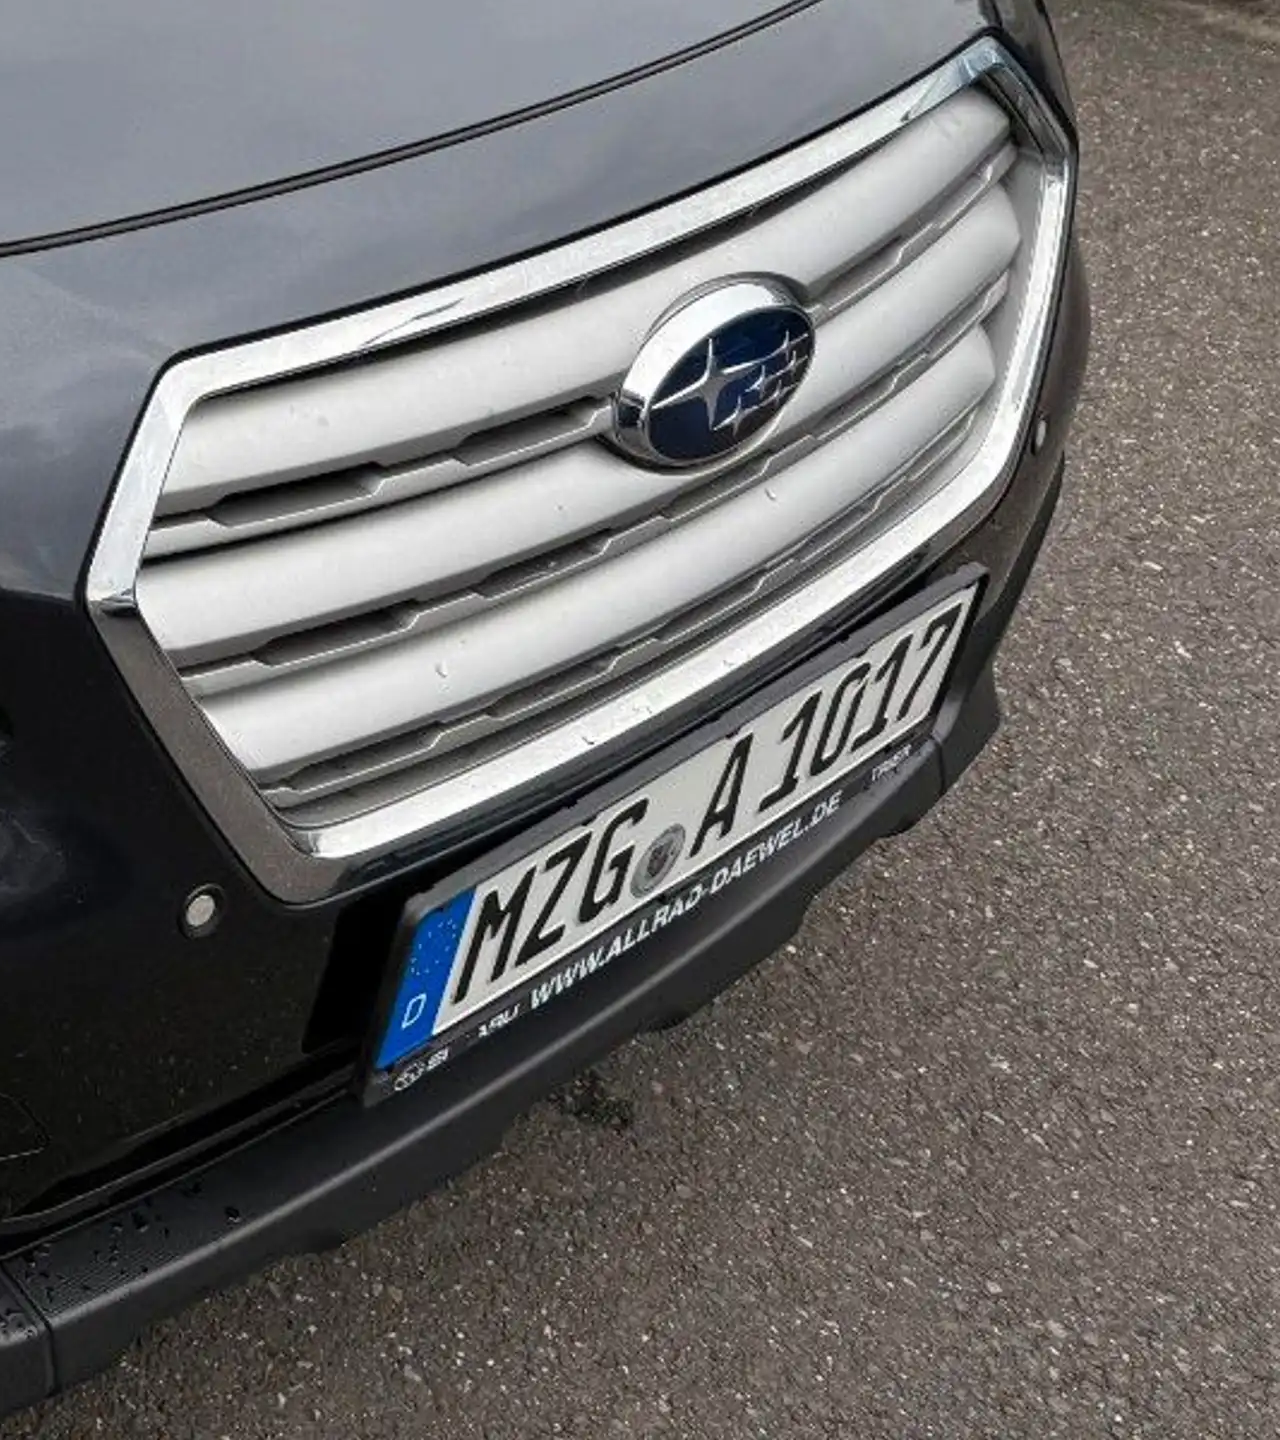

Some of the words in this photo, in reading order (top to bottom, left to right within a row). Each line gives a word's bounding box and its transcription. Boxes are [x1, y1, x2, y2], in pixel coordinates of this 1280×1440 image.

[451, 797, 650, 1004] MZG
[689, 733, 752, 858] A
[757, 602, 962, 813] 1017
[531, 789, 843, 1010] WWW.ALLRAD-DAEWEL.DE
[401, 992, 428, 1029] D
